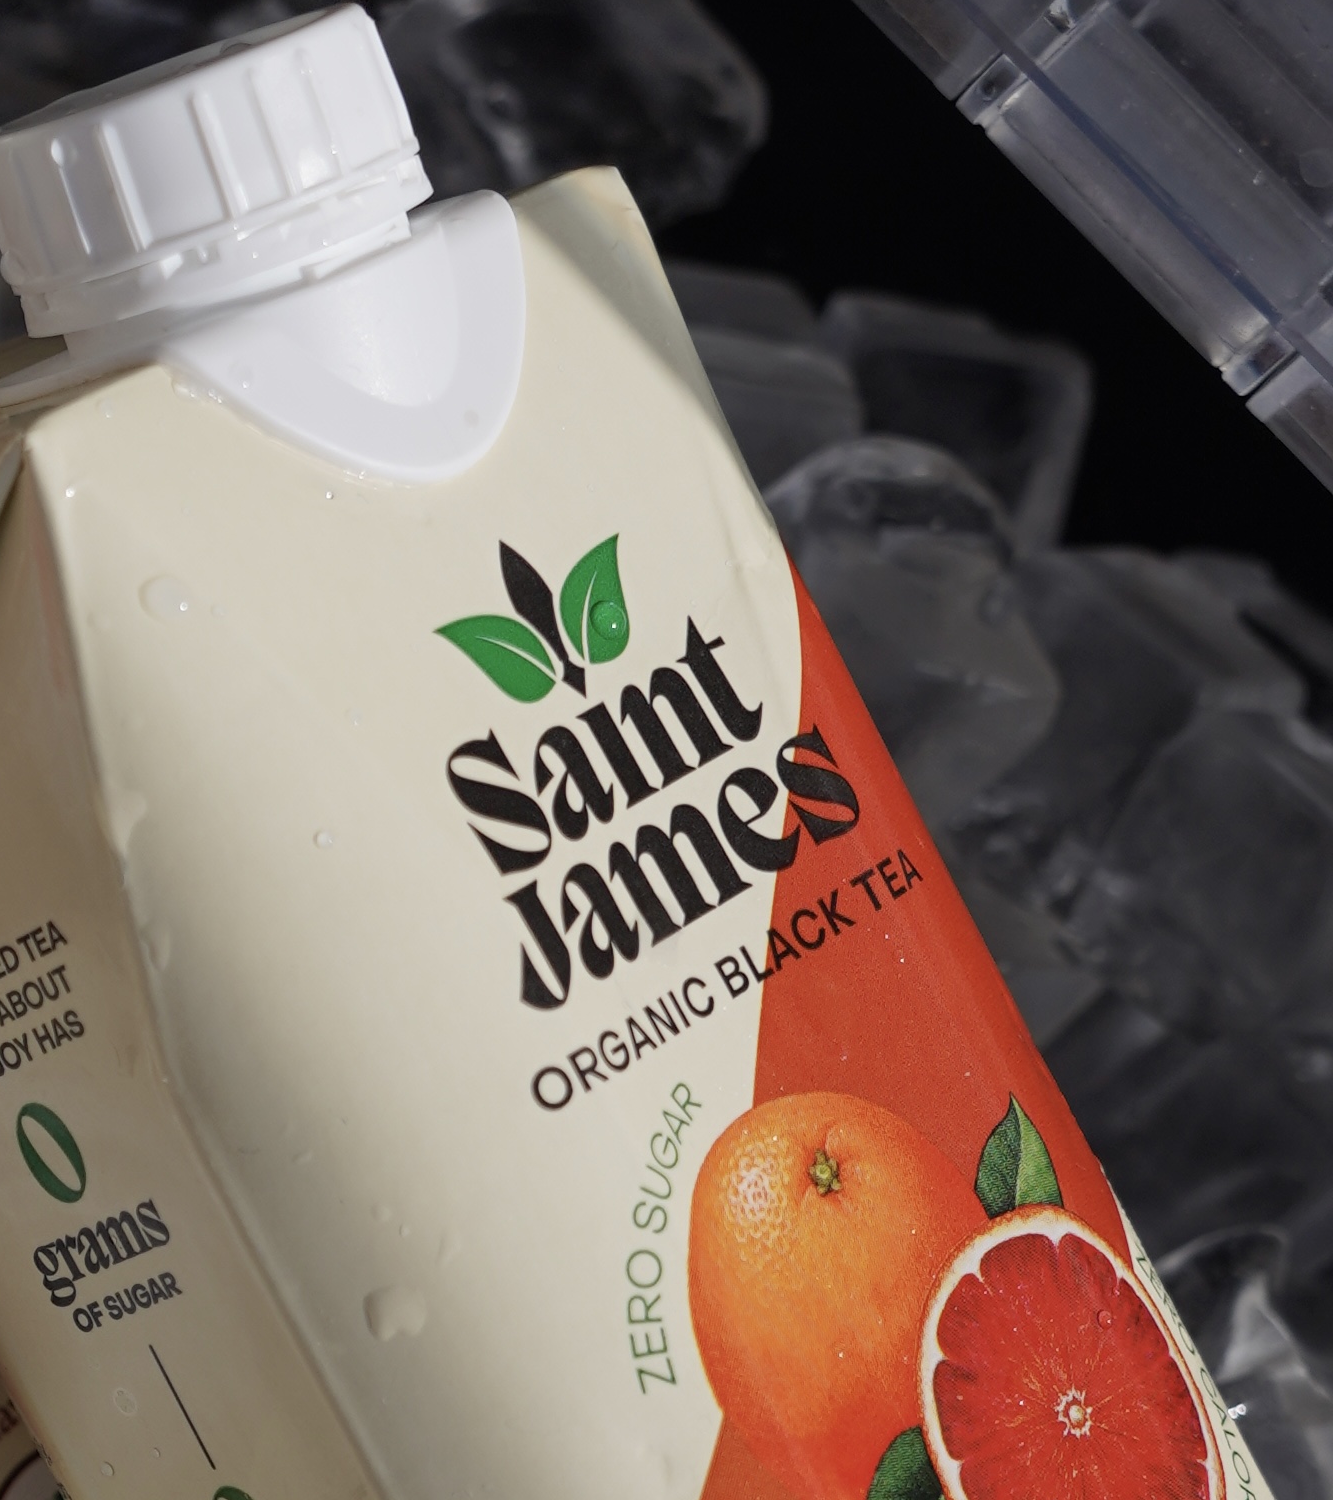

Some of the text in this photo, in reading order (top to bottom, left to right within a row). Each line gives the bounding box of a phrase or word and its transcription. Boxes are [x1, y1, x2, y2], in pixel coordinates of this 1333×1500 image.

[446, 616, 763, 878] Saint
[503, 723, 860, 1013] James
[16, 920, 68, 965] TEA
[530, 848, 923, 1112] ORGANIC BLACK TEA
[35, 1009, 85, 1054] HAS
[16, 1102, 86, 1203] 0
[34, 1198, 171, 1307] grams
[626, 1081, 702, 1395] ZERO SUGAR
[72, 1272, 182, 1333] OF SUGAR
[1135, 1244, 1195, 1356] ZERO
